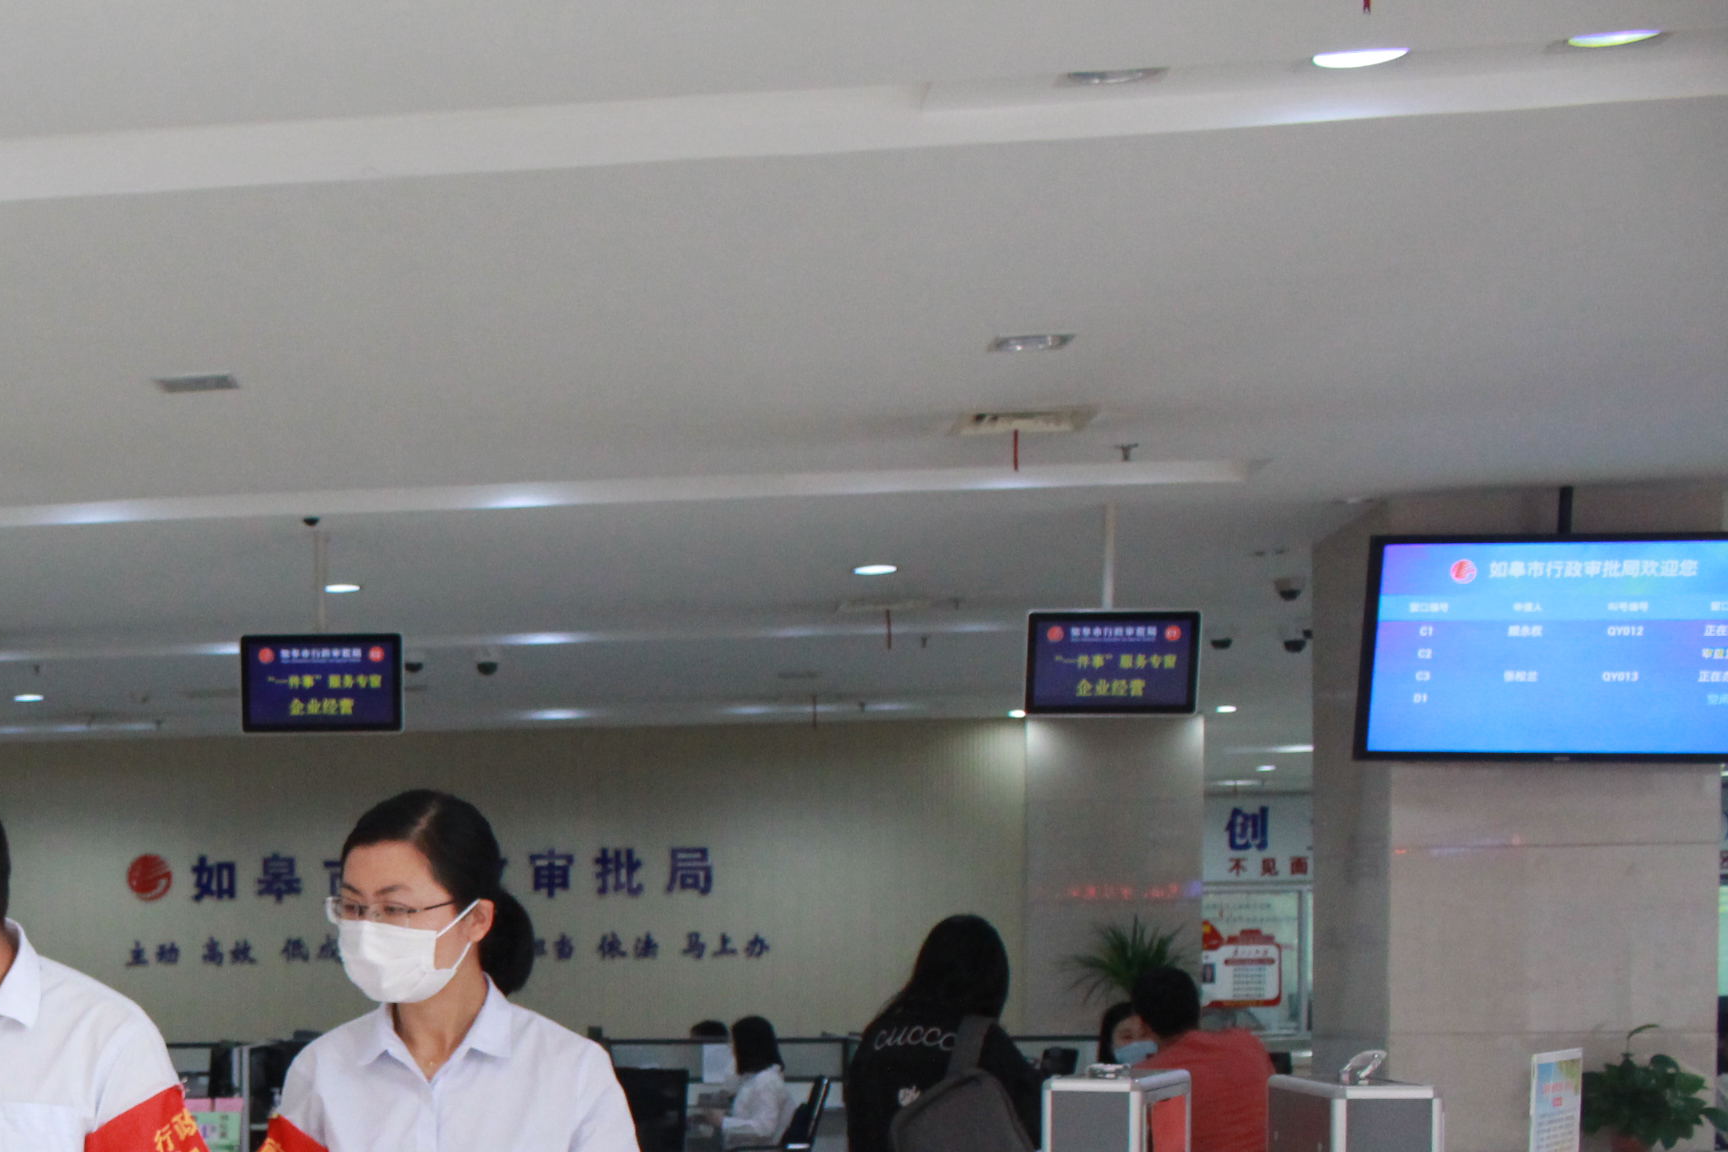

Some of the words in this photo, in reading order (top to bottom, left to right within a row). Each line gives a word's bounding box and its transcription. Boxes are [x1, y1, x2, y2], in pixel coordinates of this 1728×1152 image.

[1488, 559, 1699, 579] 如皋市行政审批局欢迎您
[1419, 625, 1433, 637] C1
[1607, 626, 1644, 637] QY012
[1418, 648, 1433, 659] C2
[1225, 805, 1270, 851] 创
[1228, 855, 1309, 877] 不见面
[126, 940, 180, 968] 主动
[202, 936, 257, 967] 高效
[598, 931, 659, 960] 依法
[682, 931, 770, 960] 马上办
